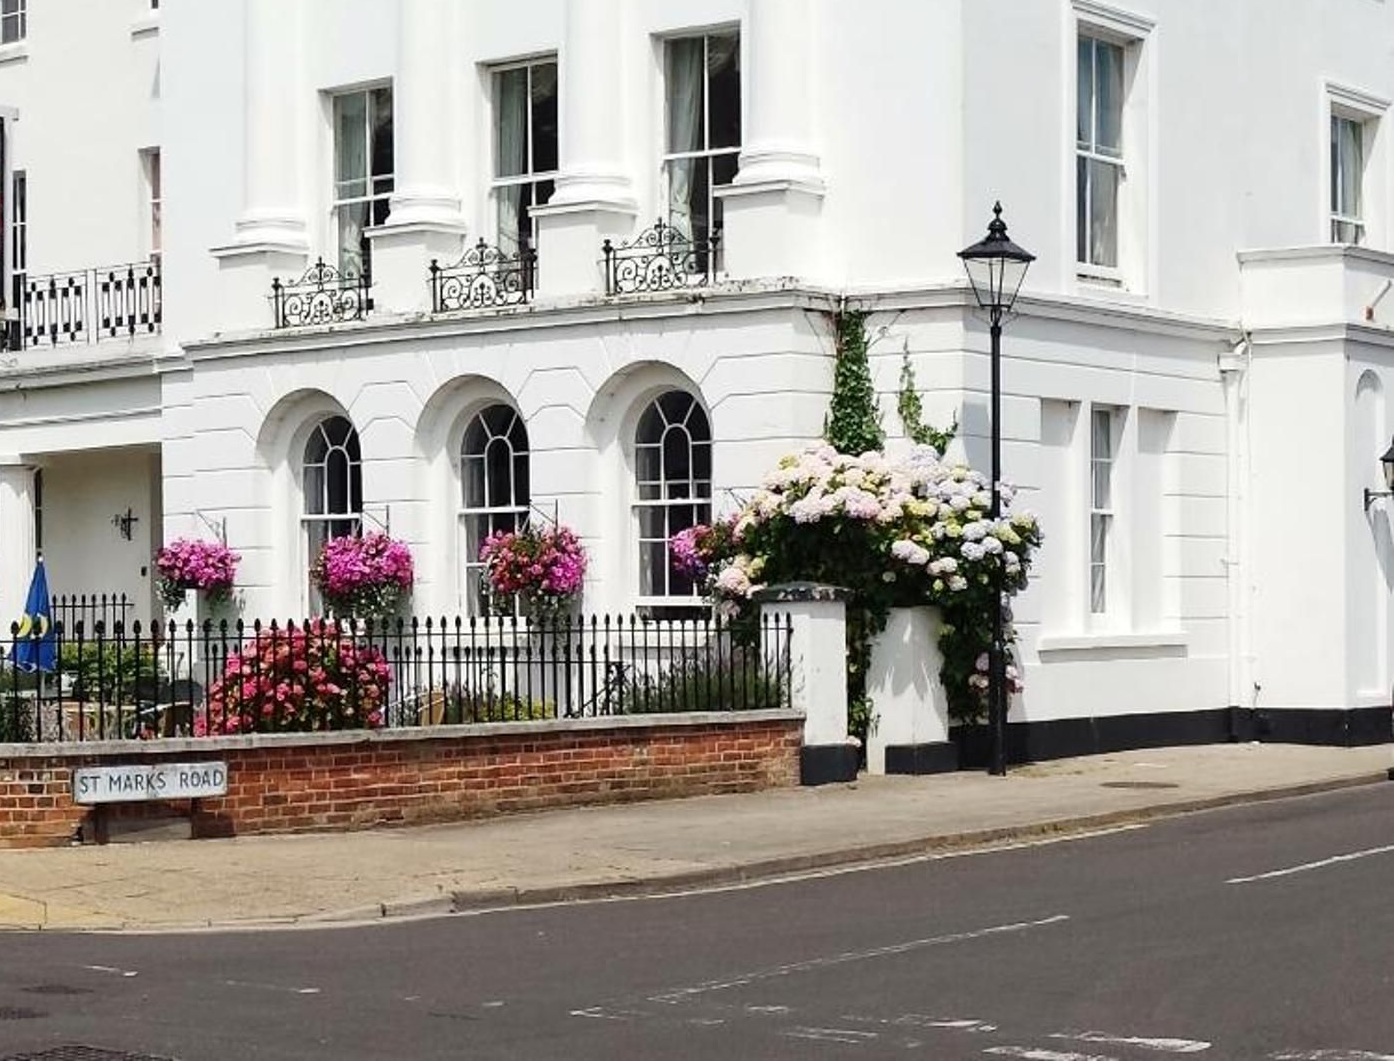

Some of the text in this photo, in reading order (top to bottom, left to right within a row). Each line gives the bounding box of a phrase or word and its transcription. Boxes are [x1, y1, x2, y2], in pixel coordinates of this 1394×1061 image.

[79, 769, 224, 794] ST MARKS ROAD
